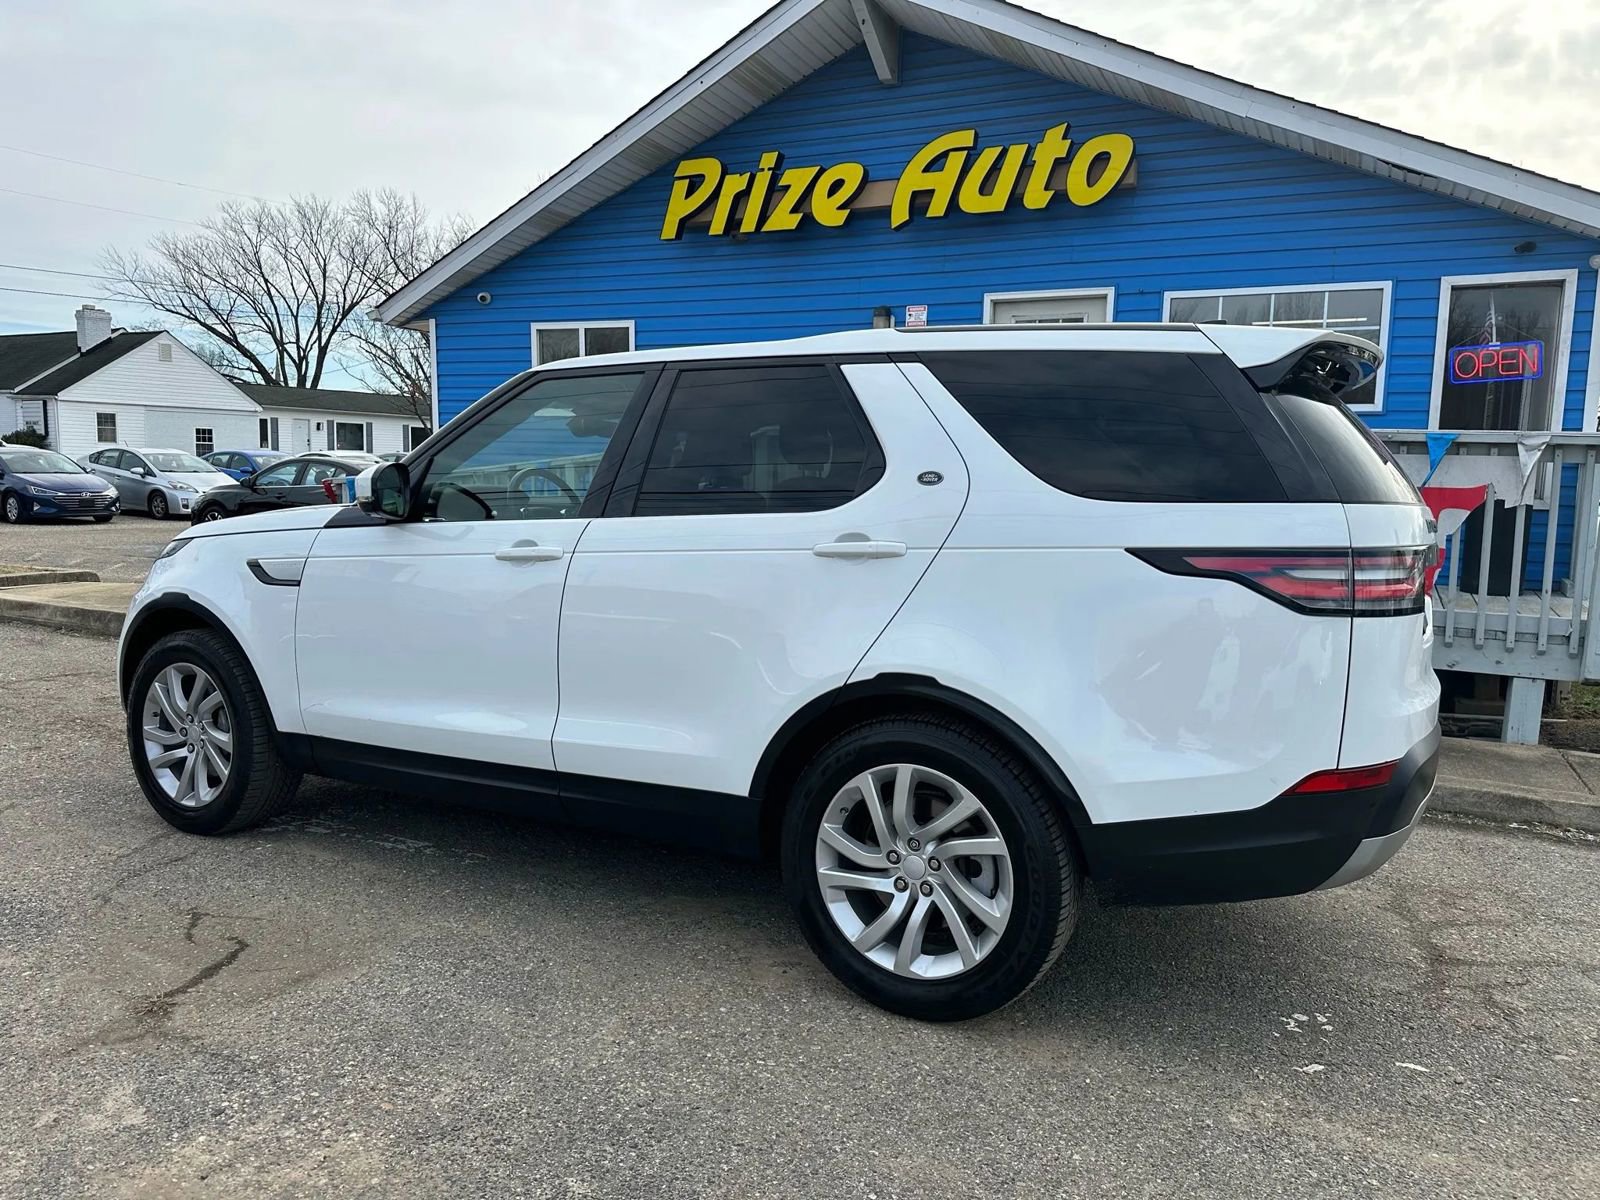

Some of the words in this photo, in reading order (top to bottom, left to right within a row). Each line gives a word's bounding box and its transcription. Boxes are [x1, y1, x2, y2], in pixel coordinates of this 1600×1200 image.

[660, 151, 868, 241] Prize
[890, 121, 1136, 230] Auto
[1455, 348, 1538, 378] OPEN
